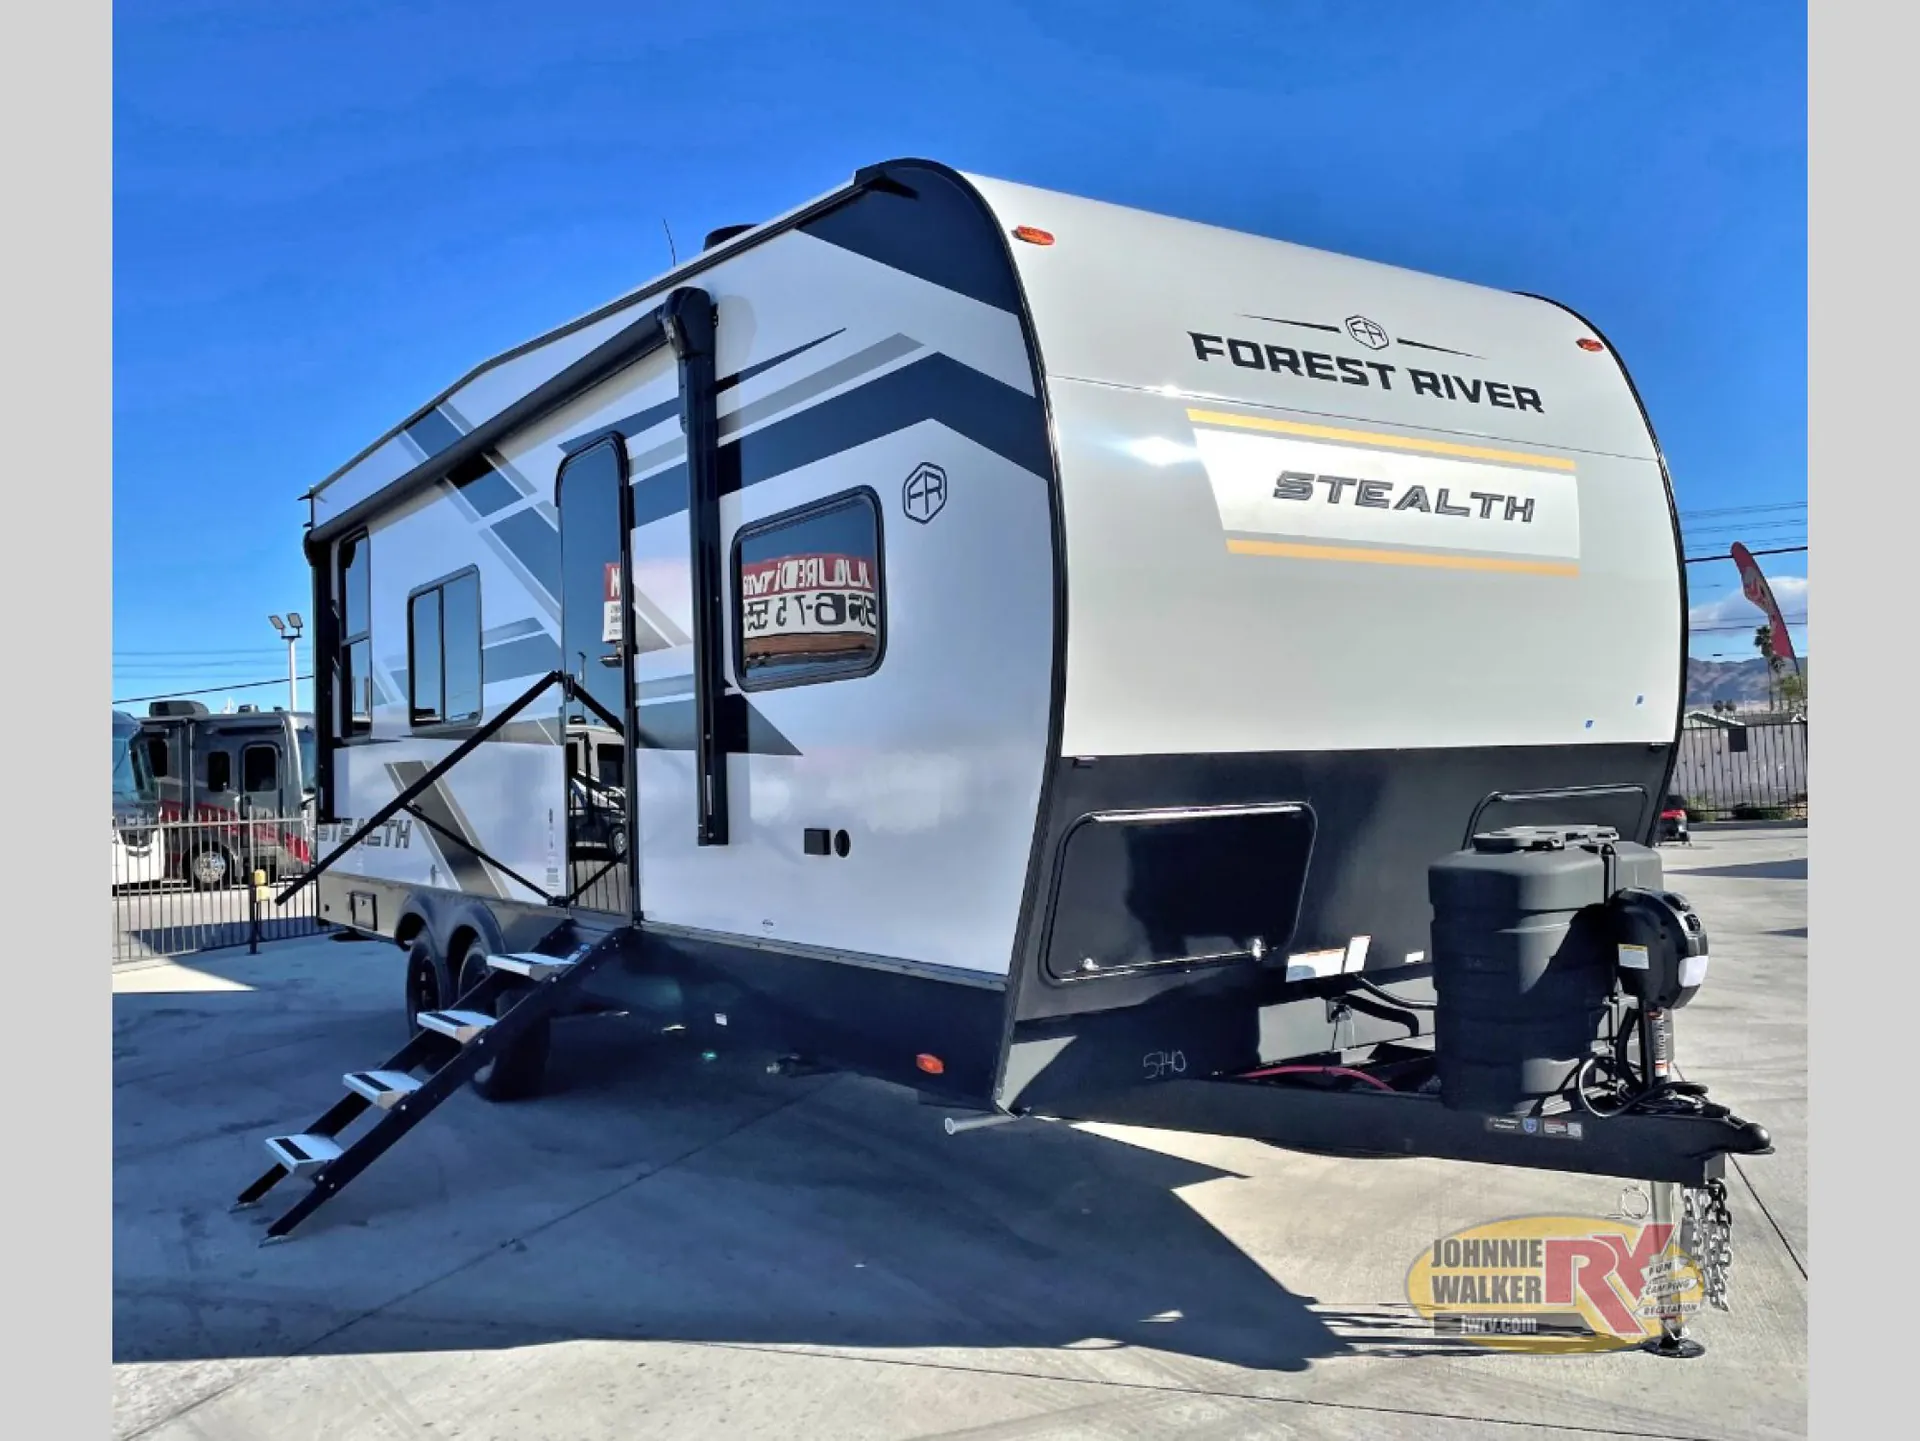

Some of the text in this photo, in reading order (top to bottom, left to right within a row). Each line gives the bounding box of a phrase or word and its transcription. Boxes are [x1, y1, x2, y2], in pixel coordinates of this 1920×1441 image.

[1187, 331, 1545, 413] FOREST RIVER
[1273, 470, 1535, 523] STEALTH
